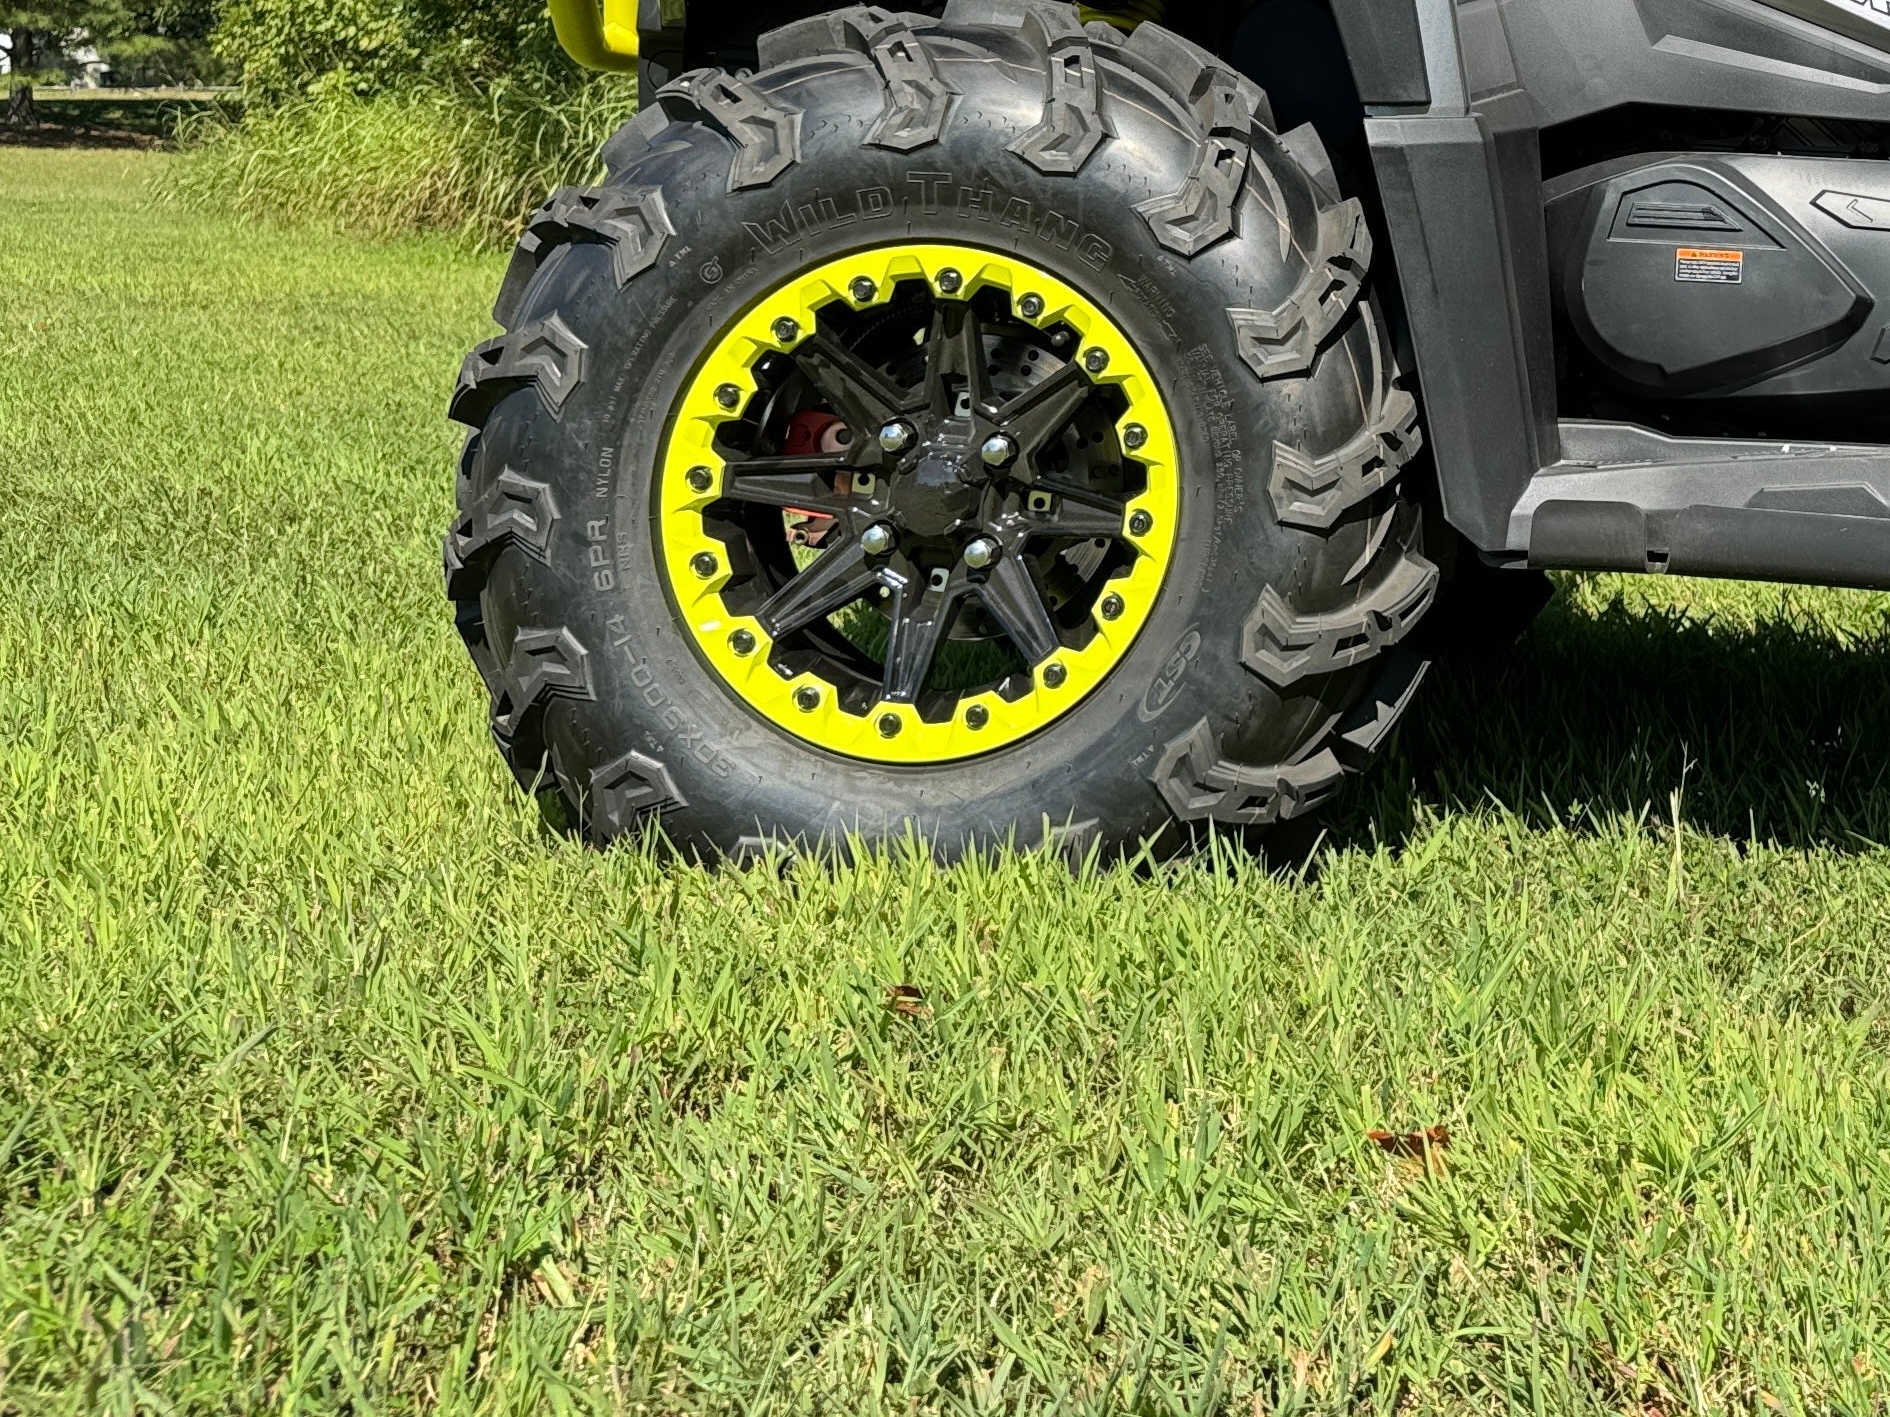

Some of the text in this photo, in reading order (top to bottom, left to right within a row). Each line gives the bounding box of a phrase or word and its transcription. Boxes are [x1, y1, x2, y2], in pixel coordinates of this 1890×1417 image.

[742, 171, 1113, 272] WILD THANG
[596, 446, 614, 498] NYLON
[586, 519, 614, 592] 6PR
[1154, 631, 1200, 705] CST
